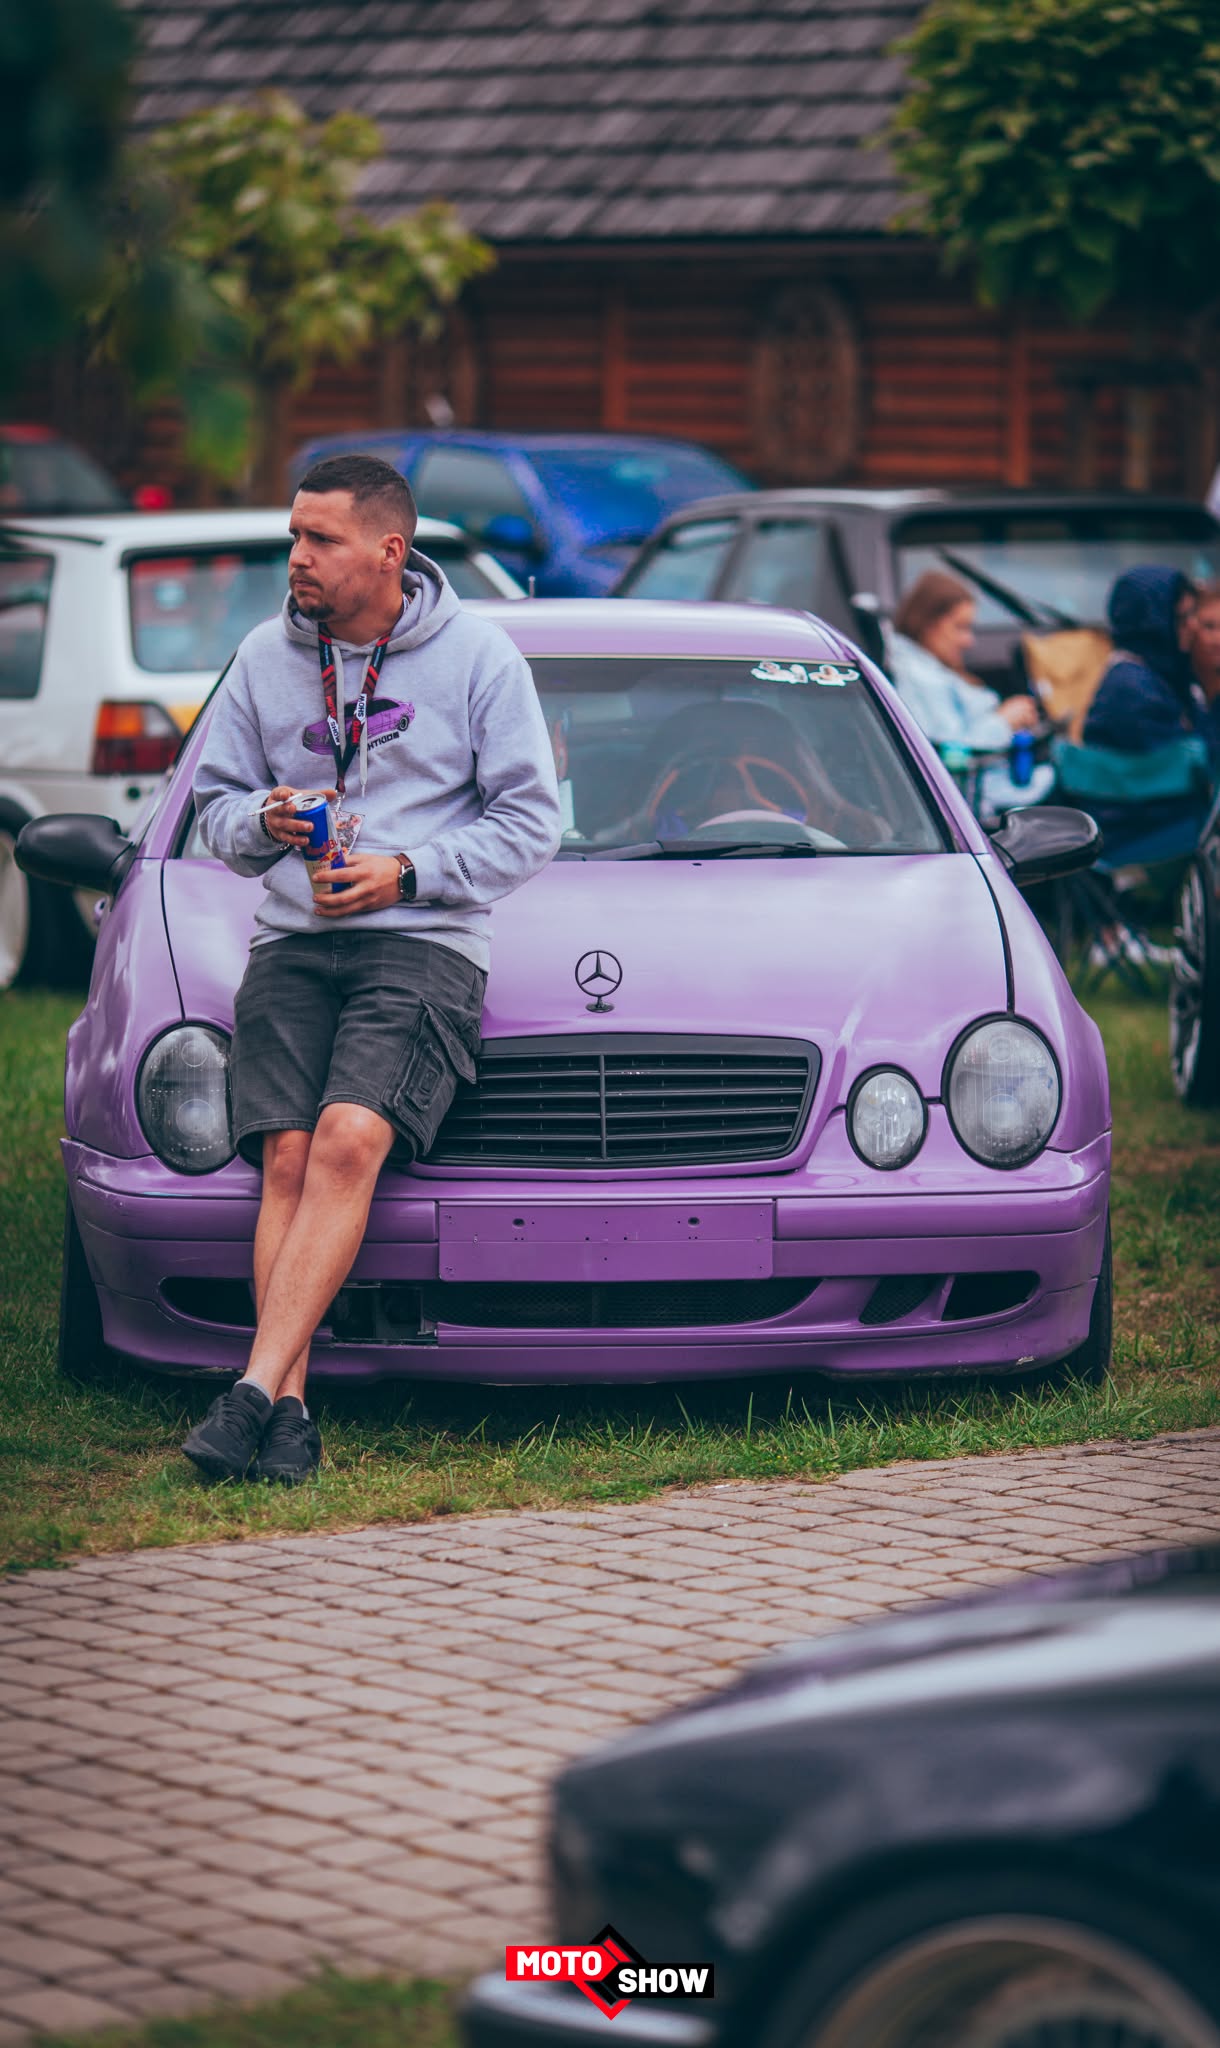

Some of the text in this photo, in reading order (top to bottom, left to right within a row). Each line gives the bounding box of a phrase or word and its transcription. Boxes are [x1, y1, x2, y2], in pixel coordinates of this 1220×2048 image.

[330, 721, 340, 744] SHOW
[351, 695, 365, 743] MOTO SHOW
